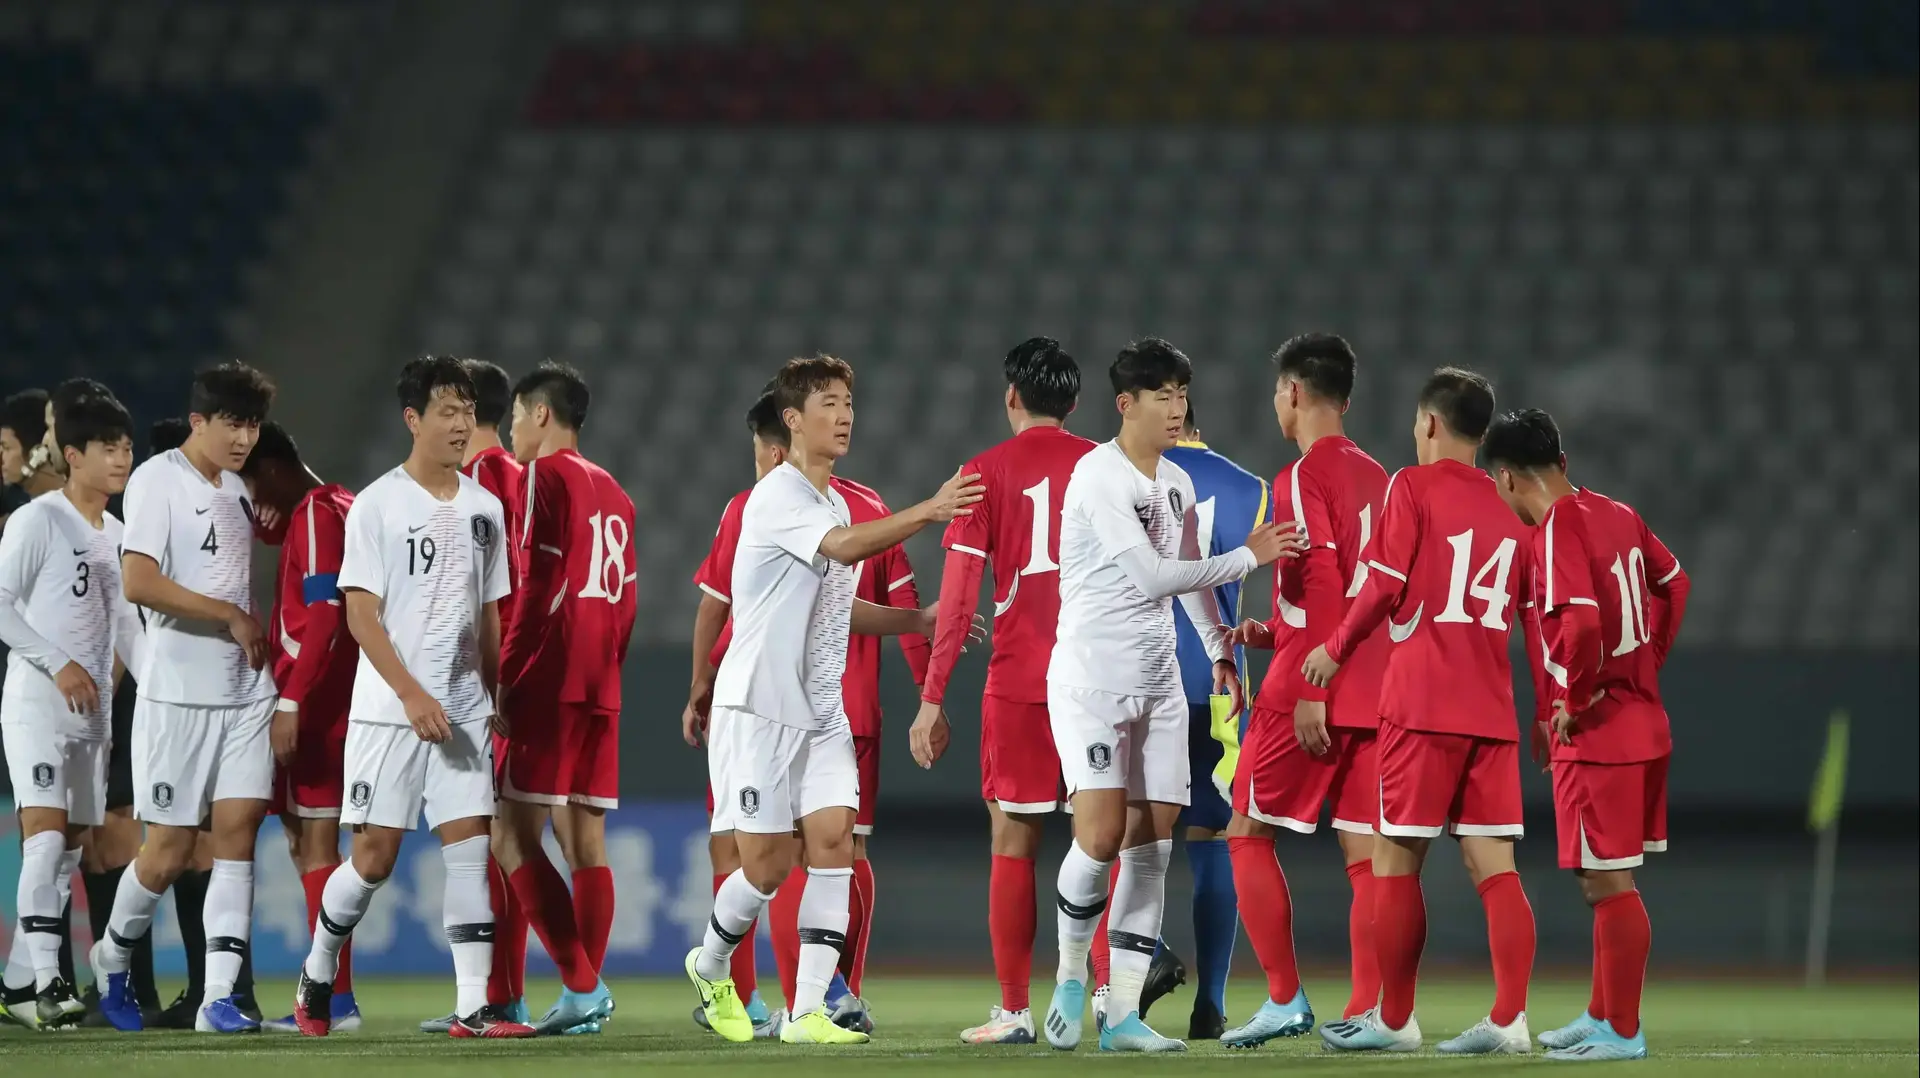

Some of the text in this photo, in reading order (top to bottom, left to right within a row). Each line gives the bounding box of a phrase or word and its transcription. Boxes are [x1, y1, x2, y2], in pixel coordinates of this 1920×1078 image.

[200, 520, 219, 556] 4
[406, 537, 436, 576] 19
[578, 509, 628, 604] 18
[72, 561, 89, 598] 3
[1433, 528, 1517, 631] 14
[1610, 547, 1651, 657] 10
